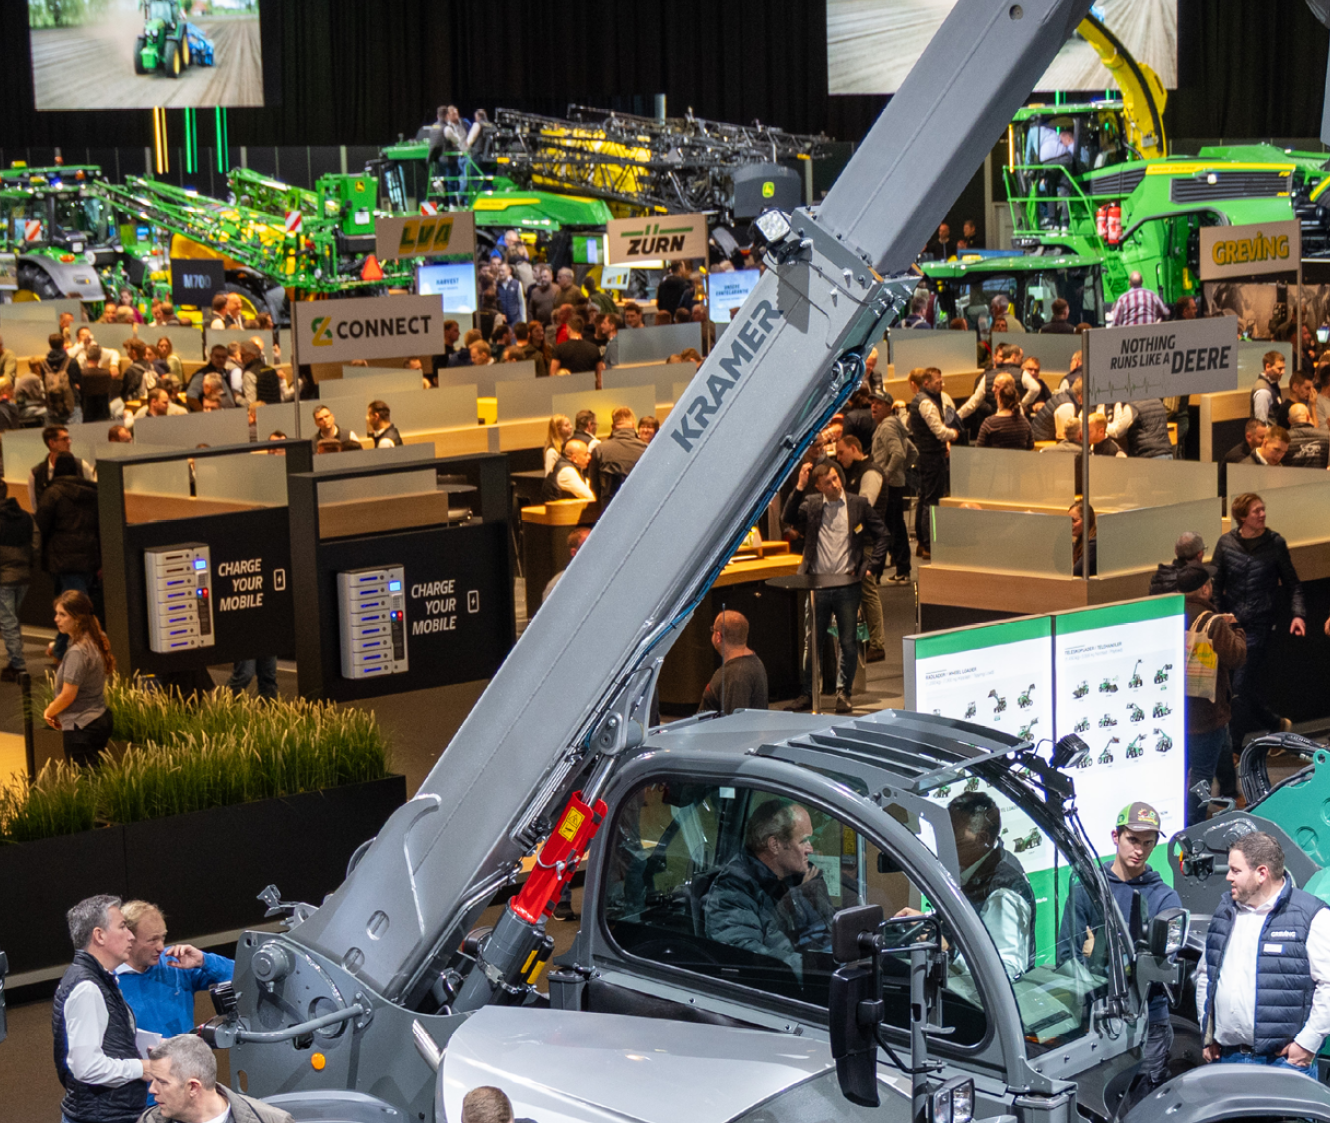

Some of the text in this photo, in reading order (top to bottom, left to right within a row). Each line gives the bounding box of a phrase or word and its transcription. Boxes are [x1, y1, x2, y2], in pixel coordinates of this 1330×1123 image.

[400, 221, 453, 247] LVA
[182, 273, 212, 289] M700
[336, 315, 432, 340] CONNECT
[1120, 334, 1176, 355] NOTHING
[1110, 345, 1232, 374] RUNS LIKE A DEERE
[671, 299, 784, 454] KRAMER
[217, 558, 263, 578] CHARGE
[232, 576, 263, 592] YOUR
[410, 580, 456, 599] CHARGE
[219, 593, 264, 612] MOBILE
[425, 598, 456, 616] YOUR
[412, 616, 457, 636] MOBILE
